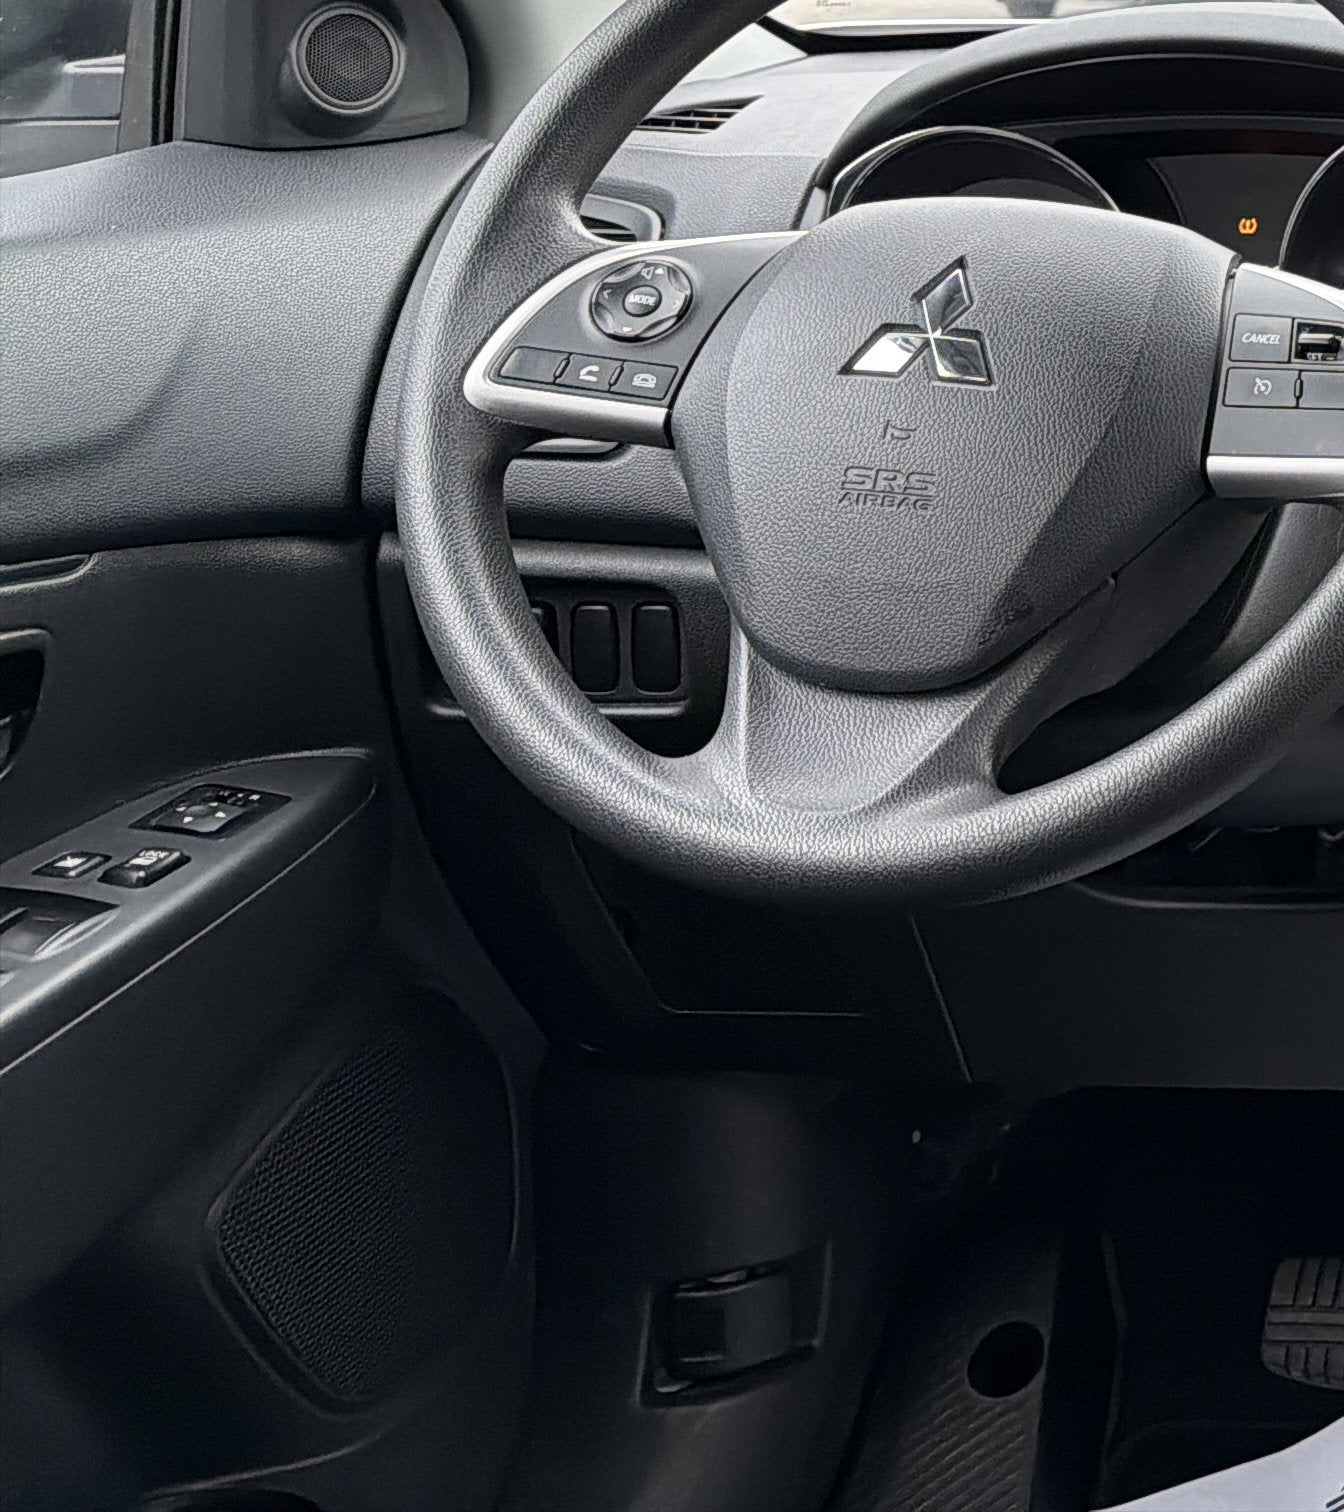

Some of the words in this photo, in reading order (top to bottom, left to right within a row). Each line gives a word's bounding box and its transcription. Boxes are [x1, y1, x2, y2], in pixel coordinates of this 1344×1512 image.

[626, 292, 657, 307] MODE
[1241, 330, 1281, 346] CANCEL
[839, 466, 937, 493] SRS
[837, 491, 934, 512] AIRBAG
